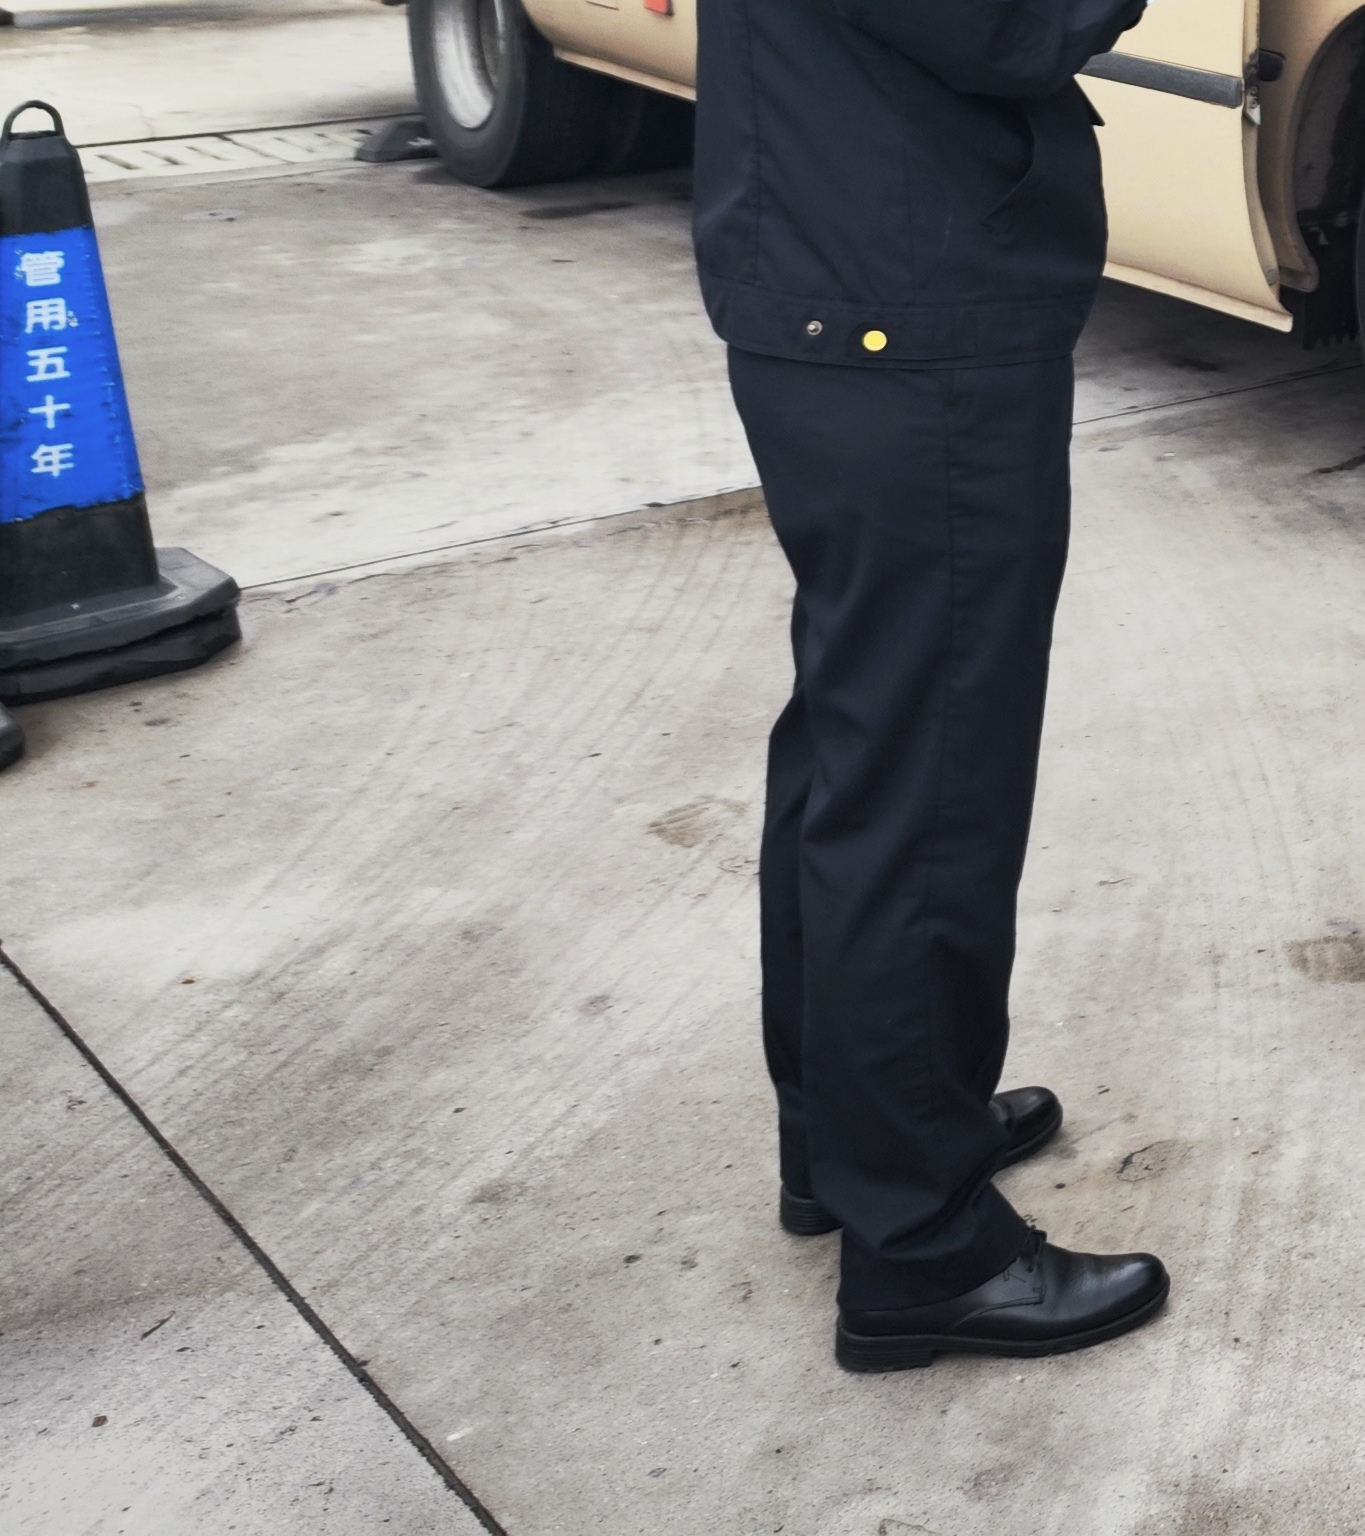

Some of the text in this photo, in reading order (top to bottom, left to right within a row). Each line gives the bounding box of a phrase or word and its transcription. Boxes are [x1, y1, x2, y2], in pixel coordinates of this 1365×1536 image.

[21, 250, 75, 478] 管用五十年
